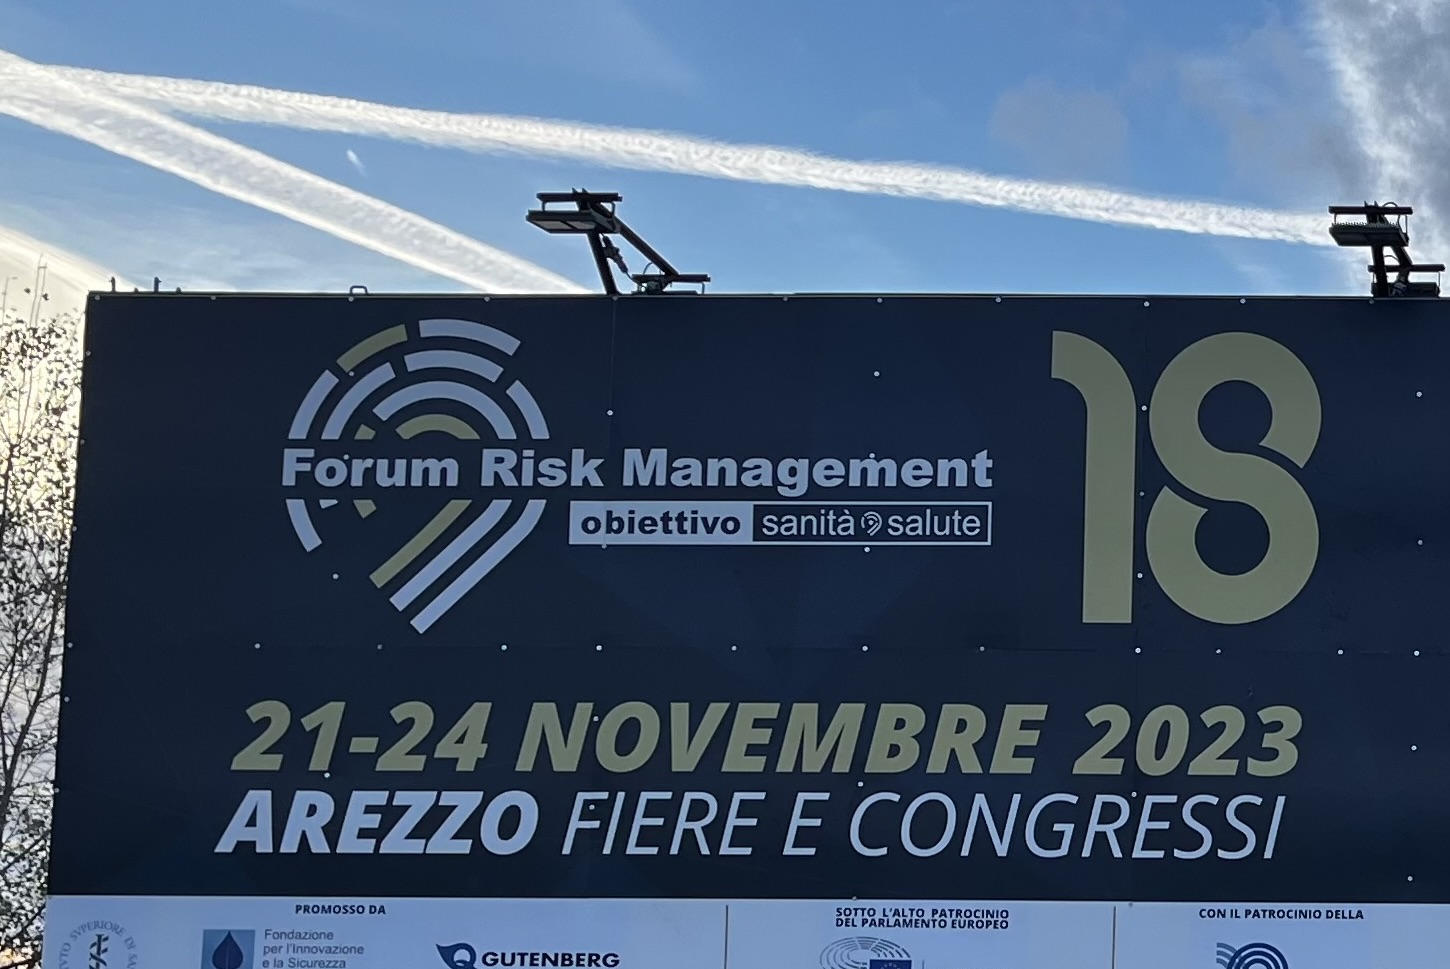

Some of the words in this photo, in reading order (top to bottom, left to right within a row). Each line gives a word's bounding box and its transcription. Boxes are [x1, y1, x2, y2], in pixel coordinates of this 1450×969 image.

[282, 449, 458, 487] Forum
[481, 449, 604, 486] Risk
[623, 449, 992, 497] Management
[1050, 330, 1322, 626] 18
[580, 510, 741, 536] obiettivo
[761, 510, 855, 537] sanità
[887, 510, 980, 538] salute
[231, 701, 492, 771] 21-24
[515, 702, 1048, 773] NOVEMBRE
[1072, 704, 1302, 776] 2023
[214, 790, 538, 855] AREZZO
[561, 790, 756, 856] FIERE
[781, 792, 823, 857] E
[850, 792, 1285, 859] CONGRESSI
[296, 905, 365, 914] PROMOSSO
[369, 905, 386, 914] DA
[836, 908, 877, 917] SOTTO
[883, 908, 924, 917] L'ALTO
[932, 908, 1009, 919] PATROCINIO
[1199, 908, 1226, 918] CON
[1230, 908, 1241, 918] IL
[1244, 909, 1322, 919] PATROCINIO
[1326, 909, 1364, 919] DELLA
[836, 917, 857, 927] DEL
[861, 918, 947, 929] PARLAMENTO
[952, 919, 1008, 929] EUROPEO
[264, 929, 333, 940] Fondazione
[263, 945, 284, 955] per
[288, 943, 364, 954] l'Innovazione
[262, 959, 270, 968] e
[273, 958, 283, 968] la
[288, 958, 346, 969] Sicurezza
[482, 952, 620, 968] GUTENBERG
